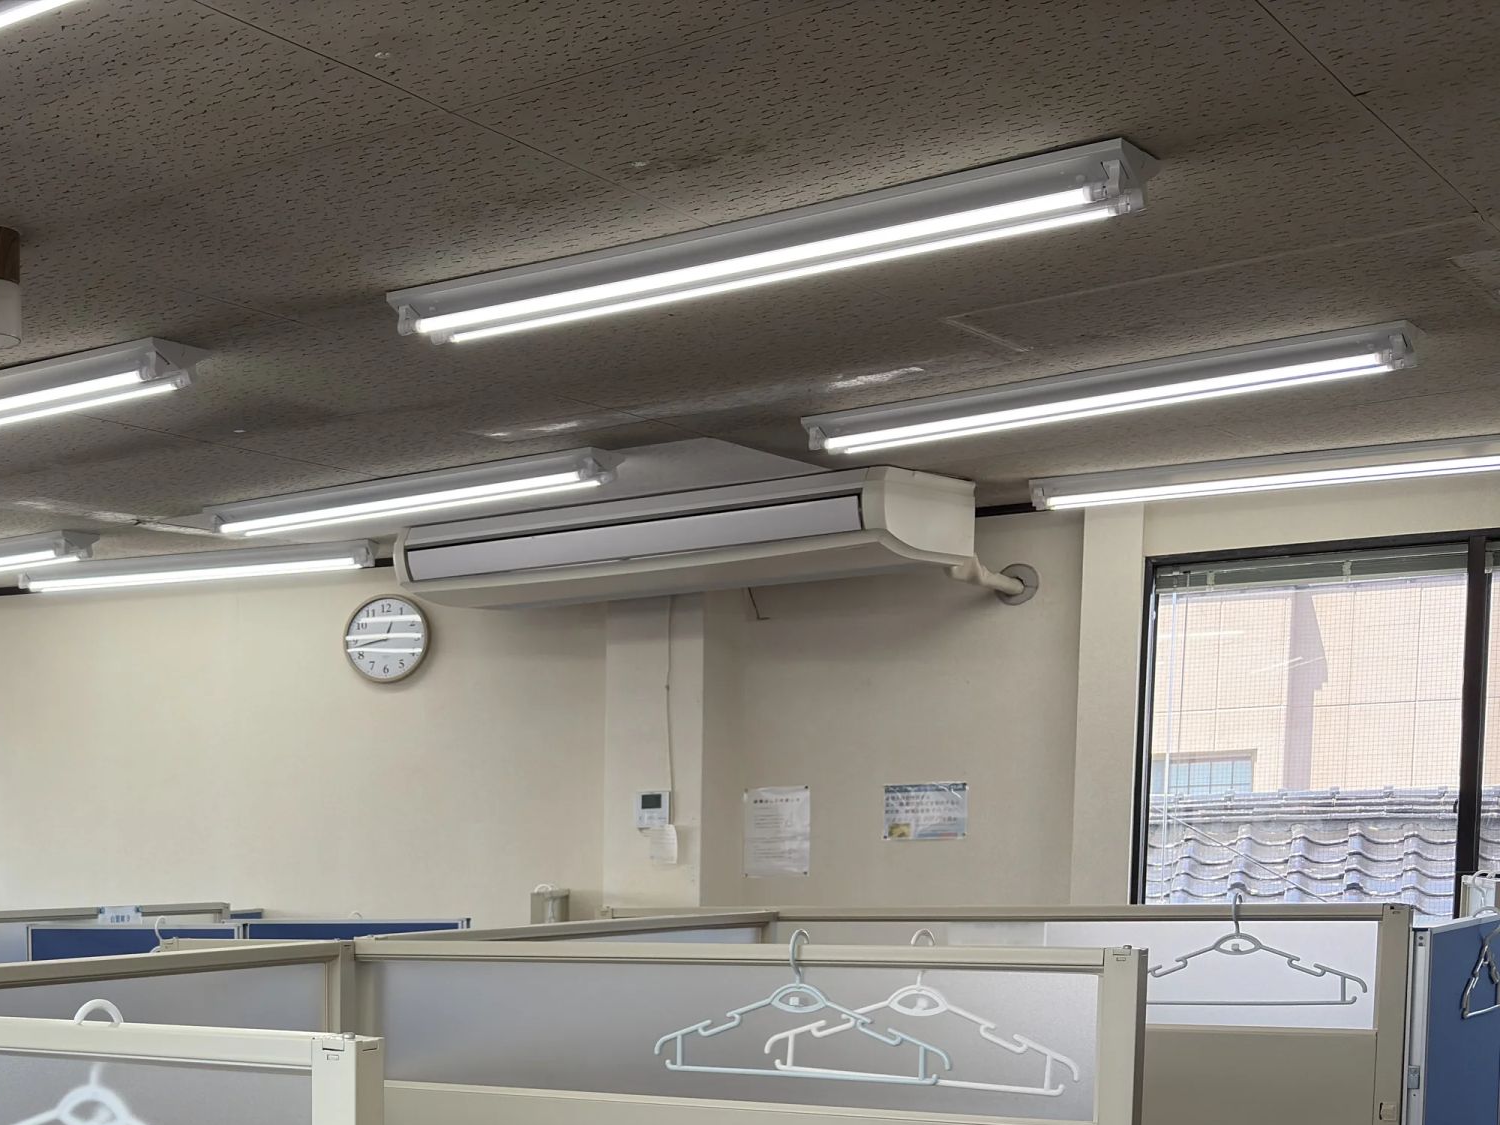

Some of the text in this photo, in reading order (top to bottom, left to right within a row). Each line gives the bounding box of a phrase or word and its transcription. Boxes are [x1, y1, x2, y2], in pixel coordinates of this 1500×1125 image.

[381, 603, 392, 613] 12
[400, 607, 404, 616] 1
[366, 609, 376, 617] 11
[357, 622, 367, 630] 10
[358, 651, 364, 660] 8
[369, 661, 375, 670] 7
[398, 659, 405, 669] 5
[383, 665, 389, 674] 6
